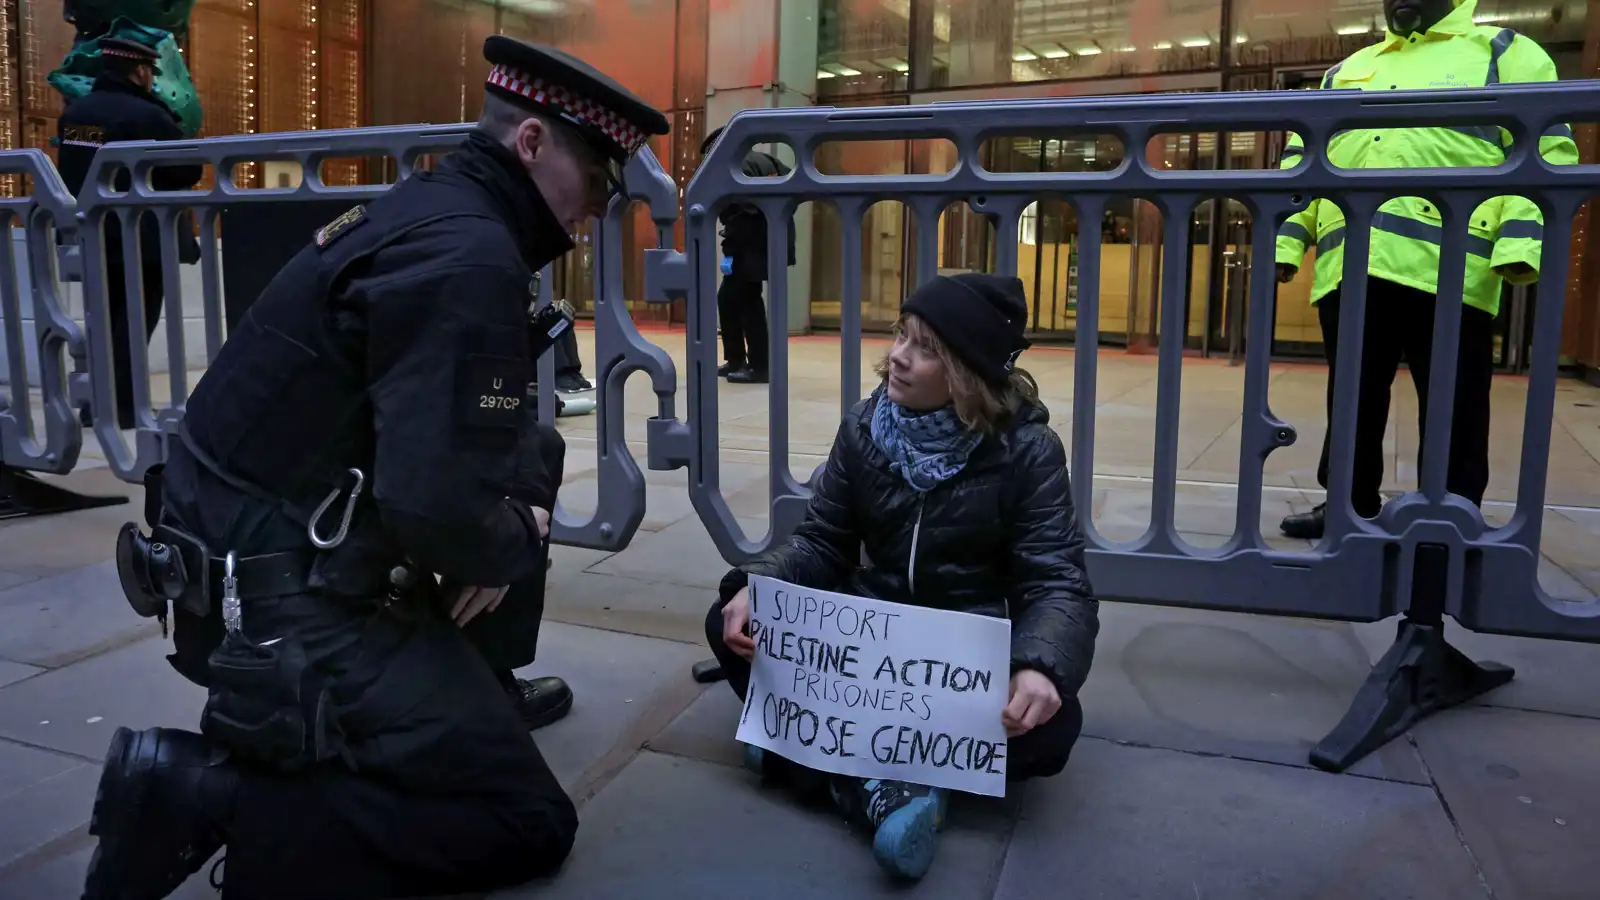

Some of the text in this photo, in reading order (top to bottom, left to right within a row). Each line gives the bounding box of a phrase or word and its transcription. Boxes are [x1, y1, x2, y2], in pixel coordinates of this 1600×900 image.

[480, 395, 520, 410] 297CP
[493, 377, 503, 390] U
[752, 580, 902, 641] I SUPPORT
[749, 619, 992, 692] PALESTINE ACTION
[793, 668, 933, 720] PRISONERS
[743, 682, 1007, 774] I OPPOSE GENOCIDE
